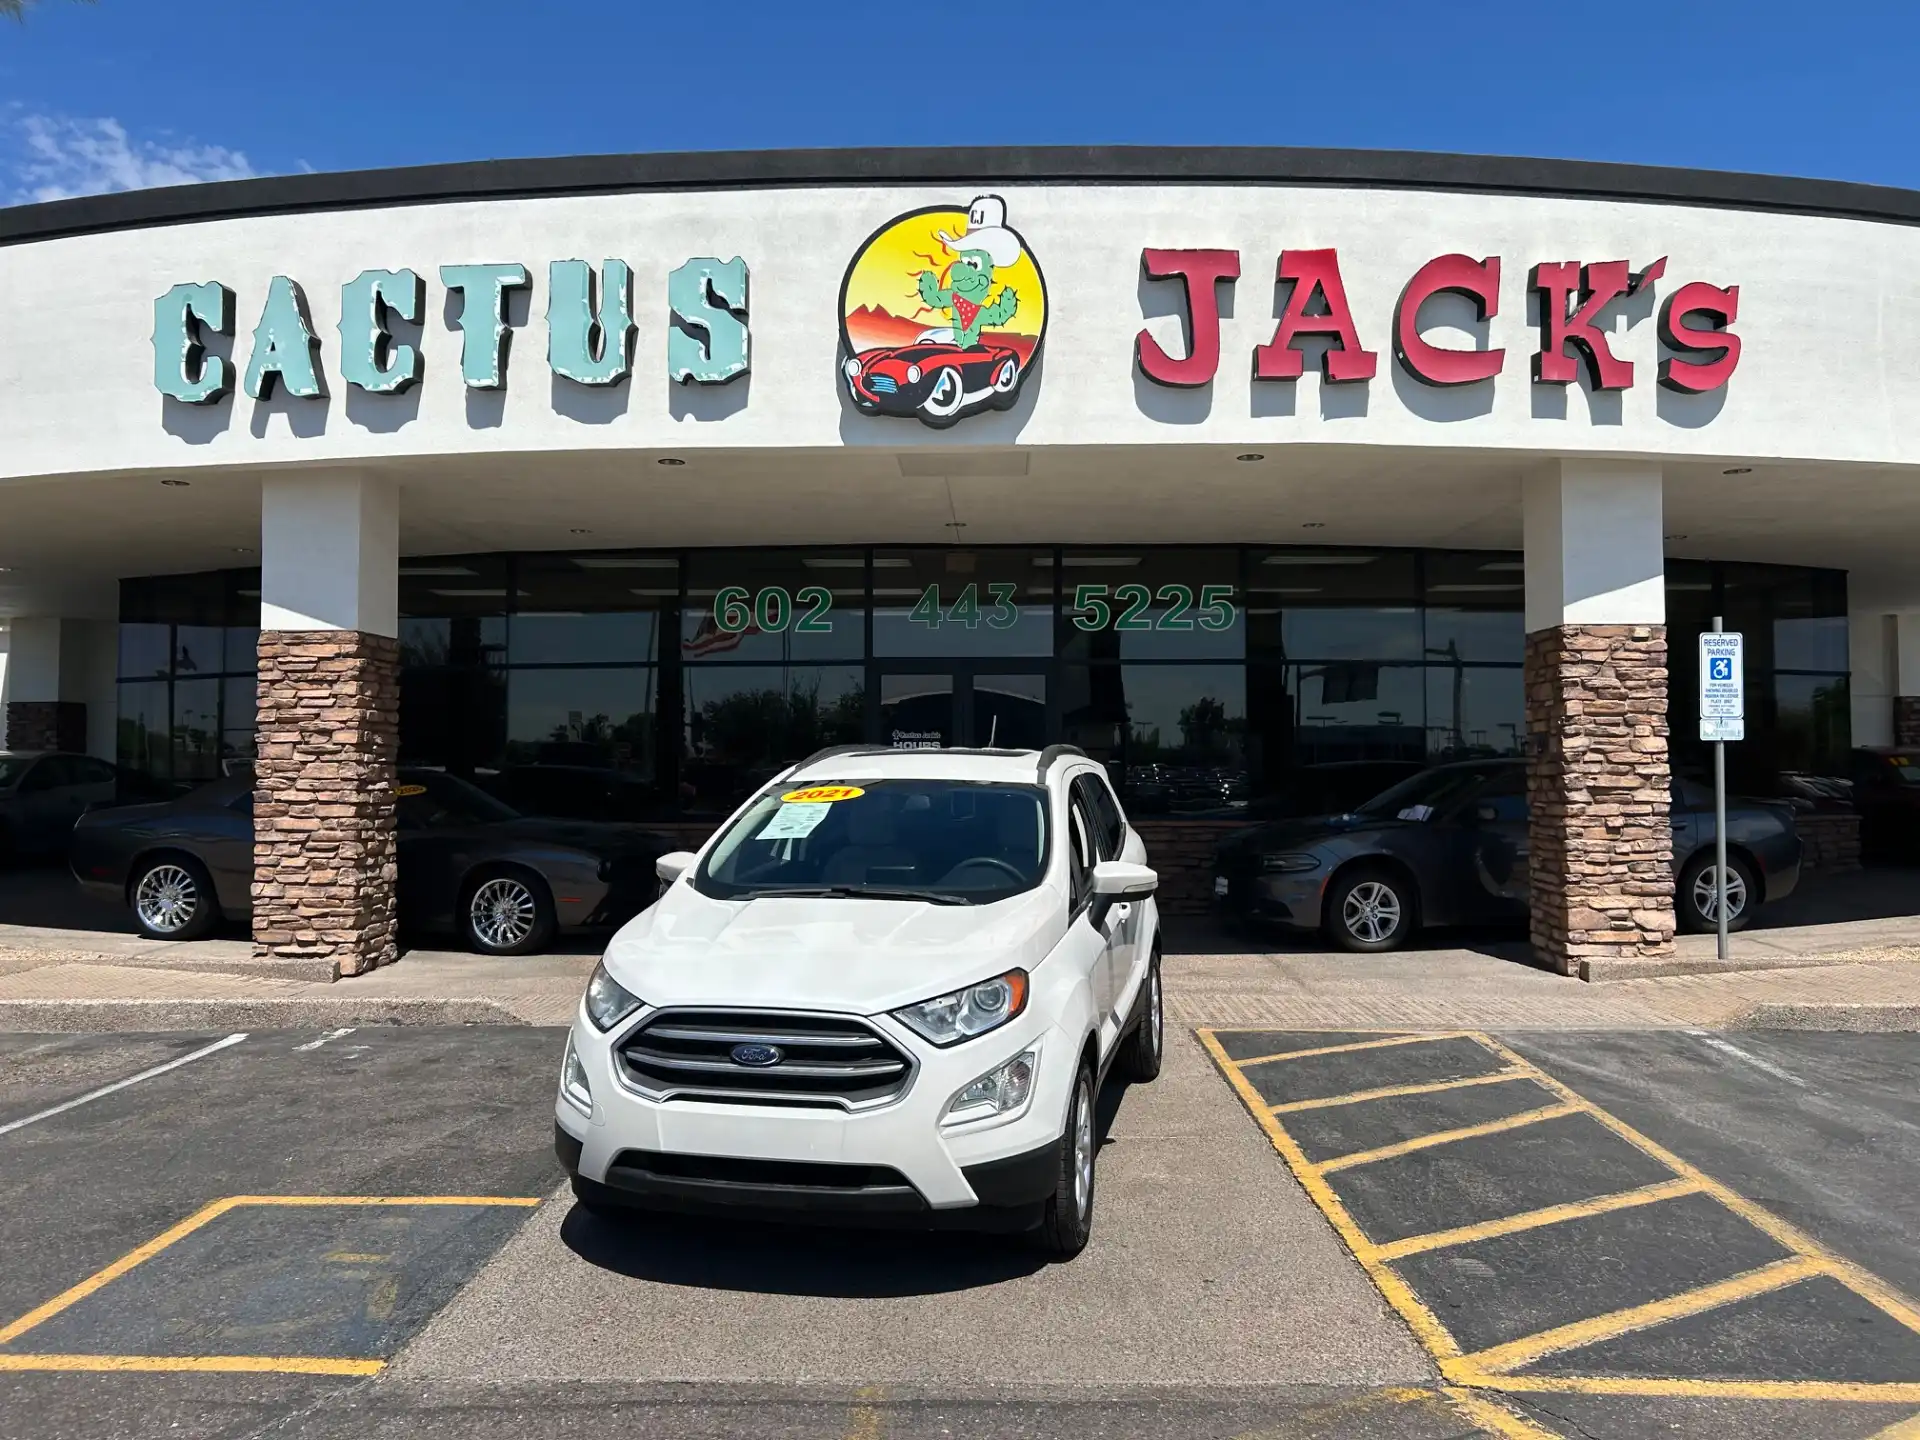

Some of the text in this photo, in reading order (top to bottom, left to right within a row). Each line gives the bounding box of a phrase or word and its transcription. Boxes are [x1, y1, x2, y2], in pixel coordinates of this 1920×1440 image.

[969, 208, 985, 226] CJ
[152, 255, 750, 405] CACTUS
[713, 582, 1237, 633] 602 443 5225
[1703, 638, 1739, 647] RESERVED
[1706, 648, 1736, 656] PARKING
[892, 741, 942, 750] HOURS
[788, 788, 855, 801] 2021
[740, 1047, 769, 1061] Ford
